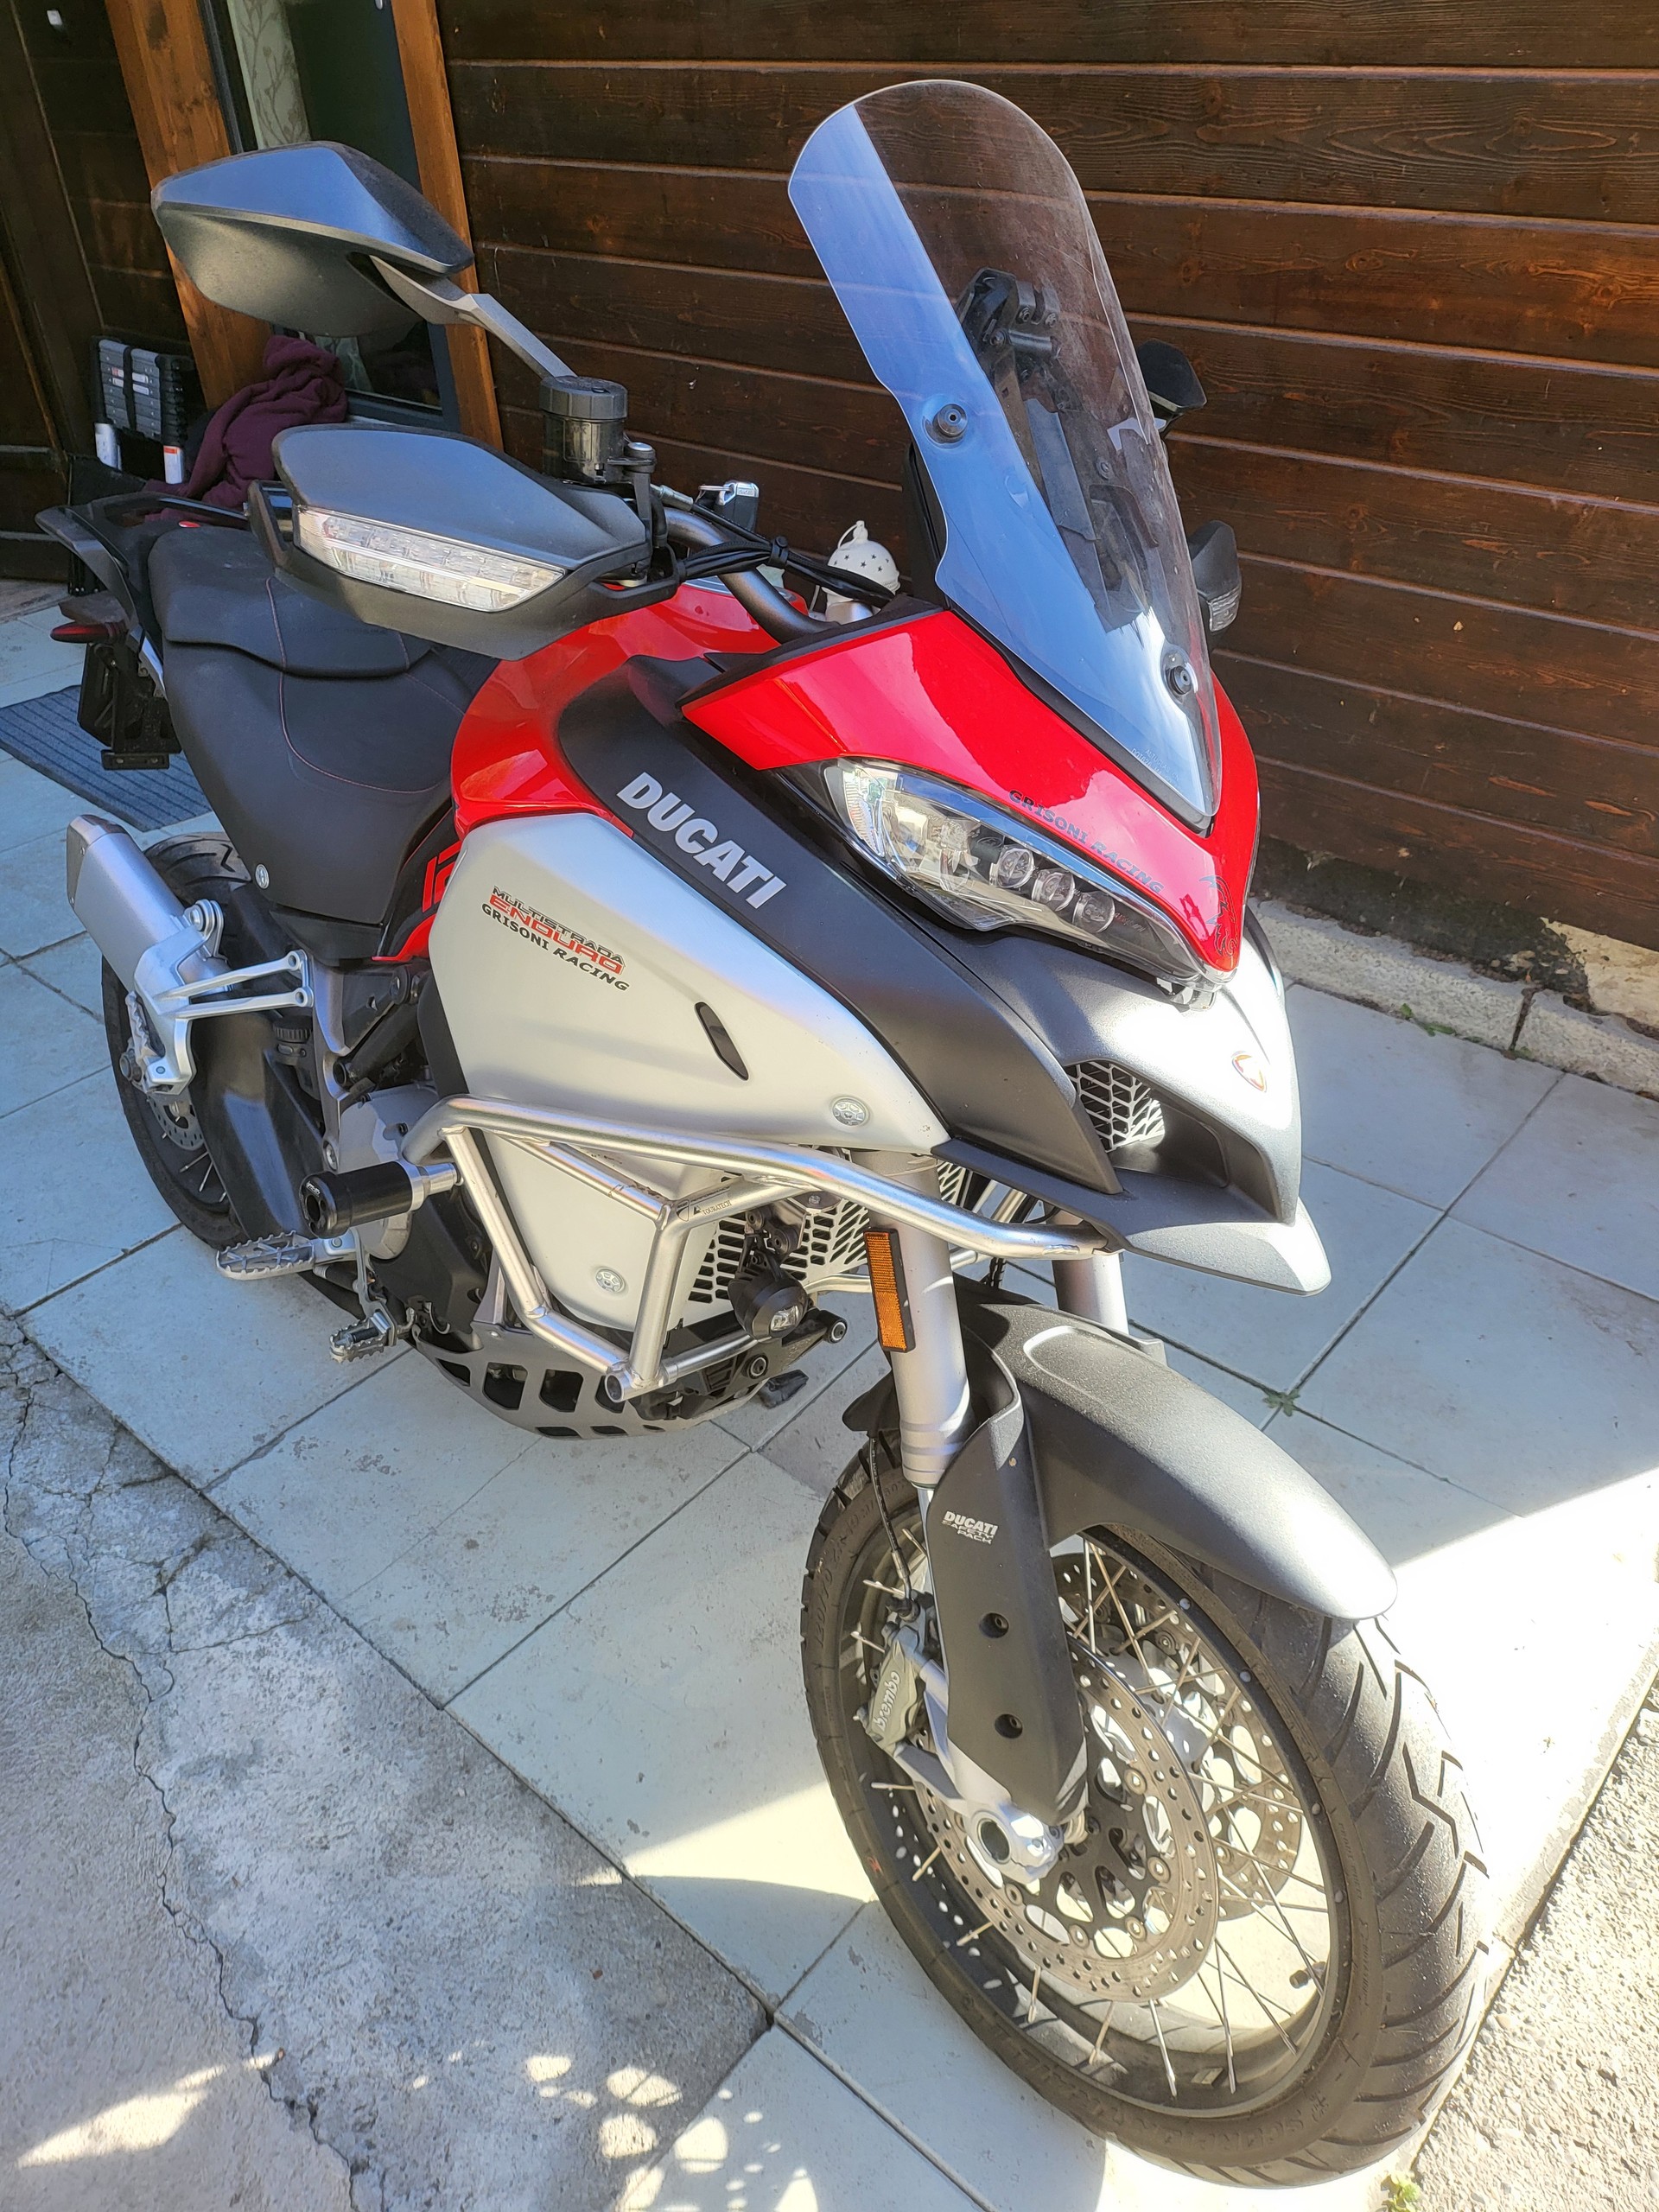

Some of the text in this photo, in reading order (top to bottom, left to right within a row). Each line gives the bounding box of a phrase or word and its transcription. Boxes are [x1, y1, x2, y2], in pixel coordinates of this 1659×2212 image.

[616, 772, 787, 910] DUCATI
[1009, 790, 1165, 894] GRISONI RACING
[481, 903, 630, 992] GRISONI RACING
[489, 894, 623, 976] ENDURO
[493, 886, 626, 967] MULTISTRADA
[702, 1199, 733, 1215] TOURATECH
[944, 1510, 999, 1536] DUCATI
[957, 1529, 993, 1545] PACK
[874, 1671, 900, 1732] brembo
